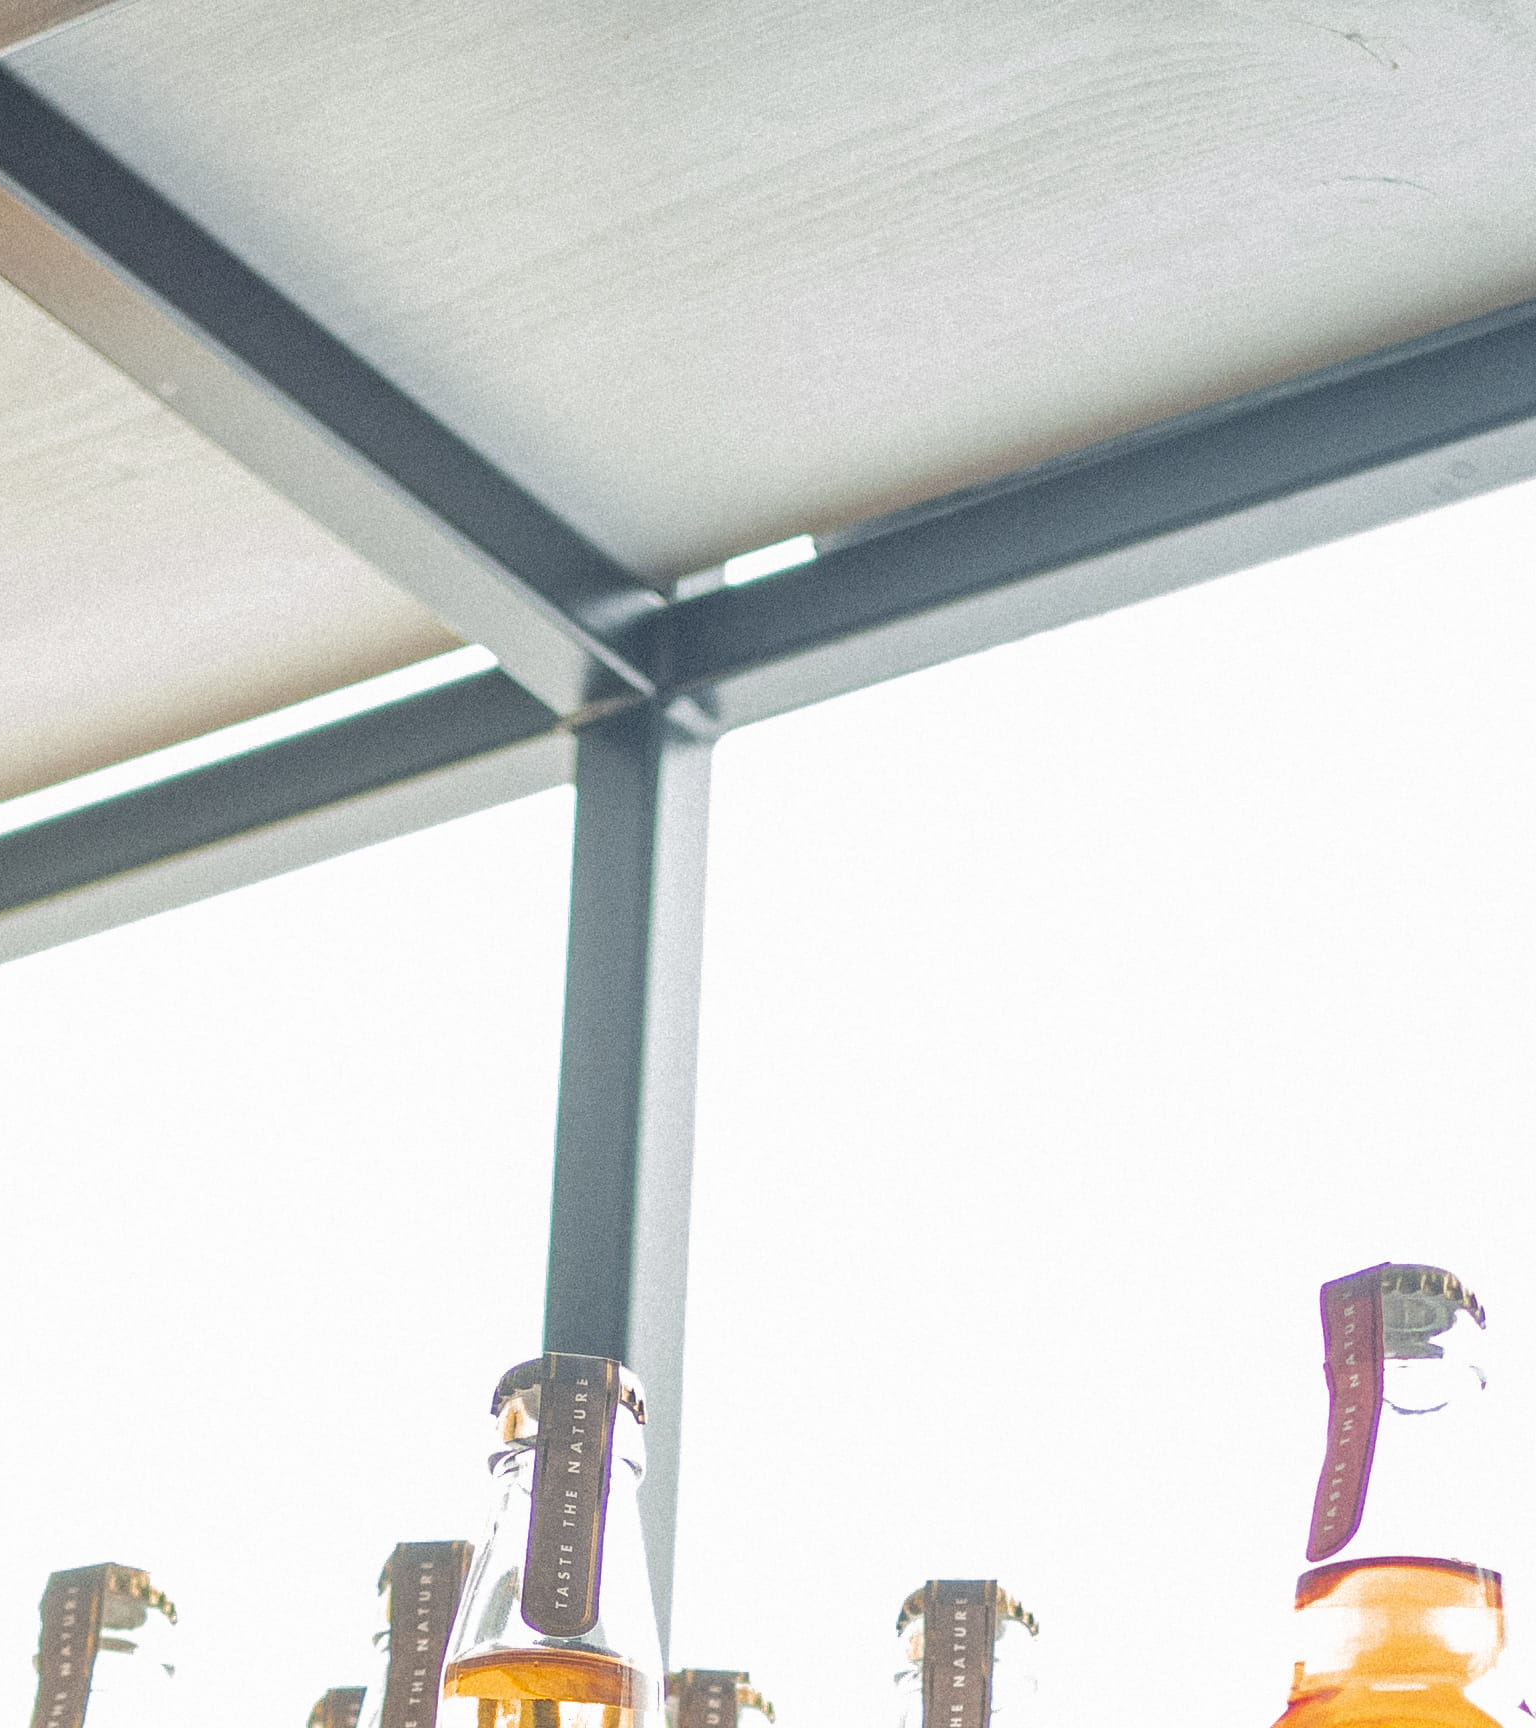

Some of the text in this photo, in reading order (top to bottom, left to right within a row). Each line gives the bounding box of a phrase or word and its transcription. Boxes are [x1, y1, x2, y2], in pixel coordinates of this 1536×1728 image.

[554, 1377, 590, 1610] TASTE THE NATURE
[1323, 1462, 1347, 1532] TASTE
[1340, 1404, 1357, 1446] THE
[409, 1667, 428, 1706] THE
[953, 1596, 969, 1689] NATURE
